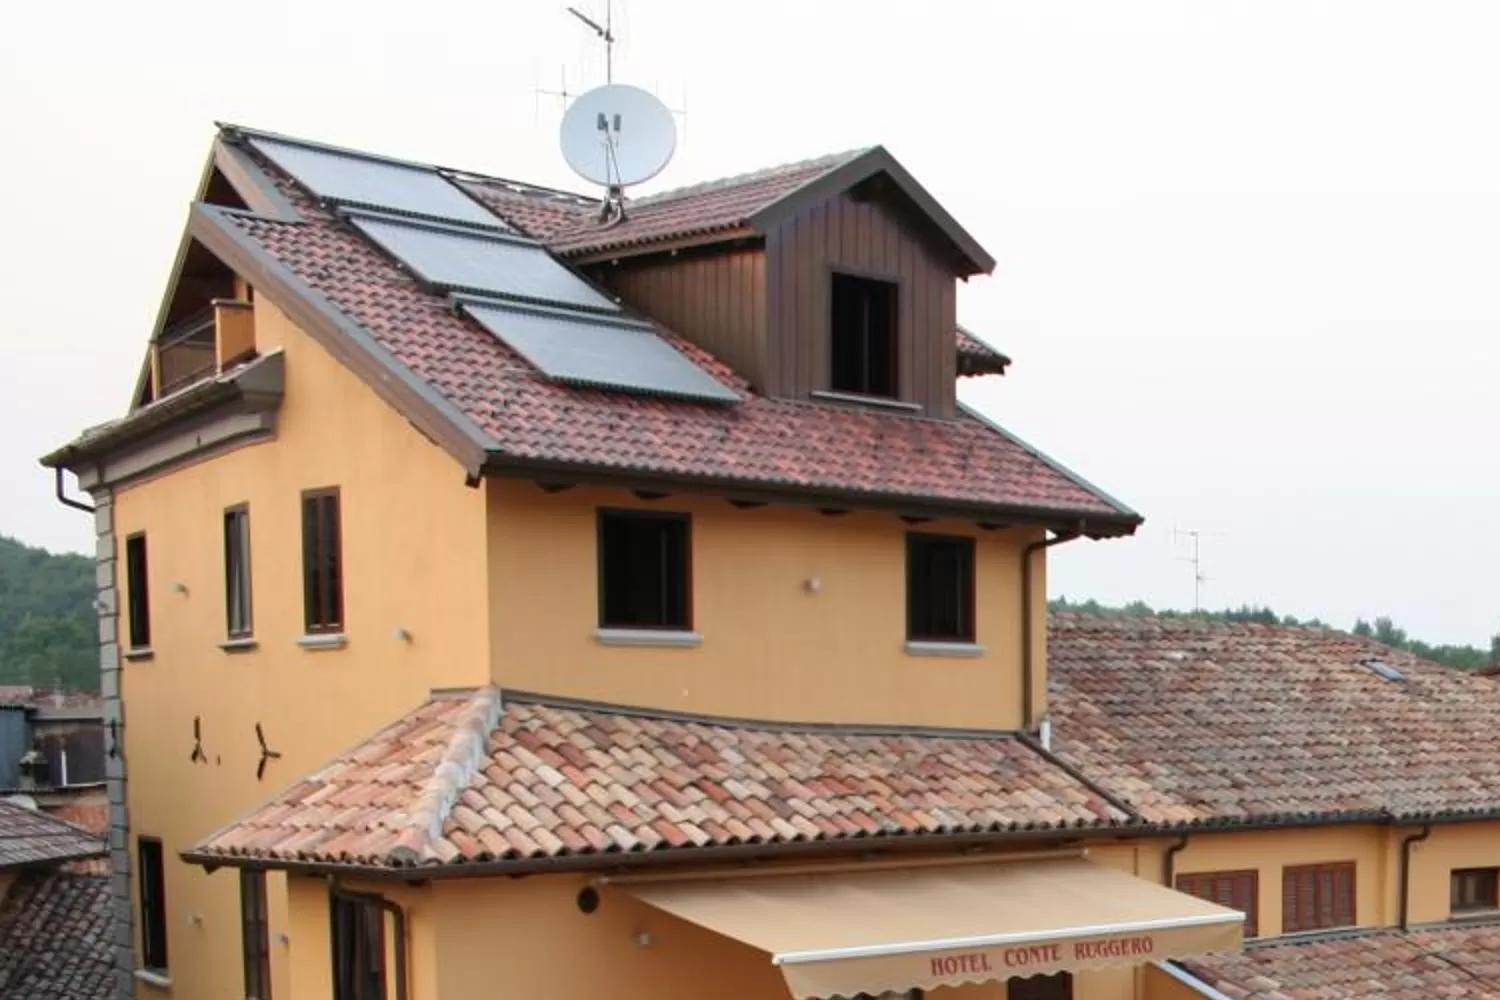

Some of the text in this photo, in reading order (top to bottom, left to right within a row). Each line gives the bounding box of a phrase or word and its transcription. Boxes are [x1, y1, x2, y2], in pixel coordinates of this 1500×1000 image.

[931, 936, 1153, 976] HOTEL CONTE RUGGERO
